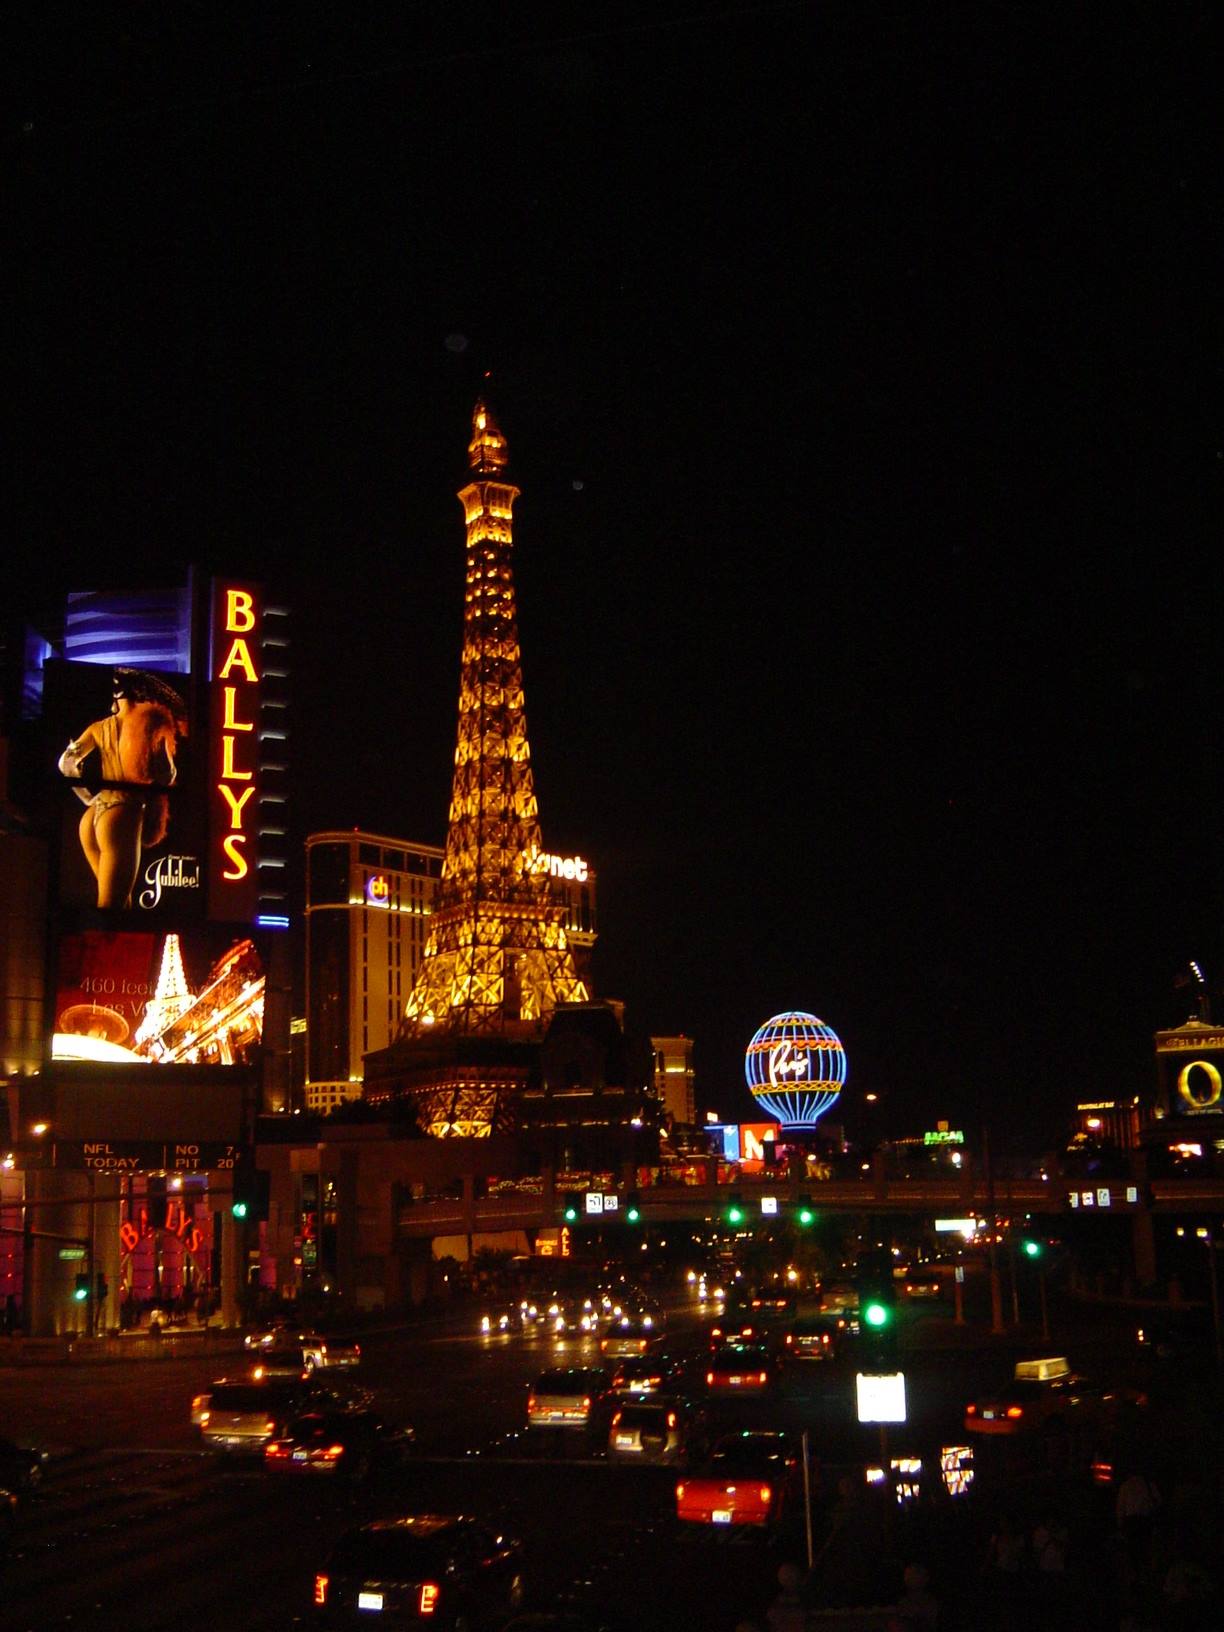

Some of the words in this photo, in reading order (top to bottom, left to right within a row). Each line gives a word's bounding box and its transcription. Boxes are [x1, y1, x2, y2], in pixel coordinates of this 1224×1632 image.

[218, 589, 259, 880] BALLYS
[139, 856, 200, 910] Jubilee!
[1167, 1037, 1224, 1049] BELLAGI
[83, 1143, 114, 1155] NFL
[175, 1144, 199, 1156] NO
[224, 1145, 234, 1156] 7
[84, 1157, 140, 1168] TODAY
[175, 1158, 201, 1168] PIT
[216, 1158, 235, 1169] 20
[120, 1201, 205, 1254] BALYS
